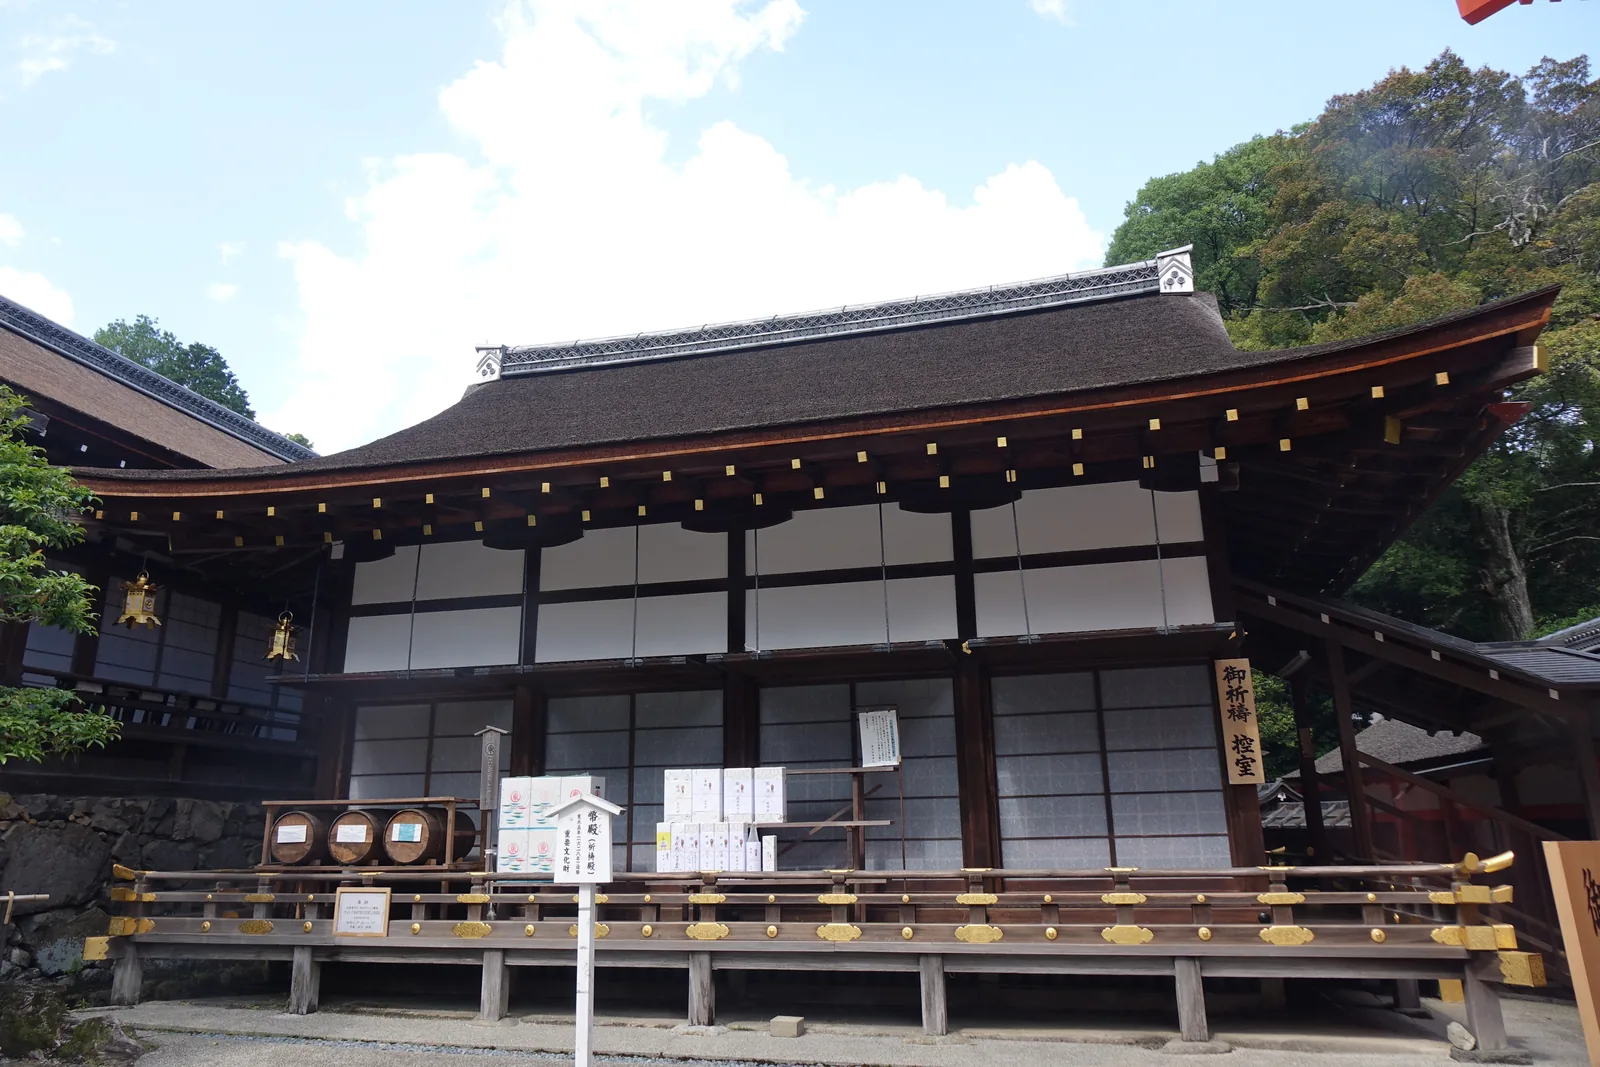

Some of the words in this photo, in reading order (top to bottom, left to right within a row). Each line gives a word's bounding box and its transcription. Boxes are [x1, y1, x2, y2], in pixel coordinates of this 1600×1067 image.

[563, 829, 571, 873] 重要文化財
